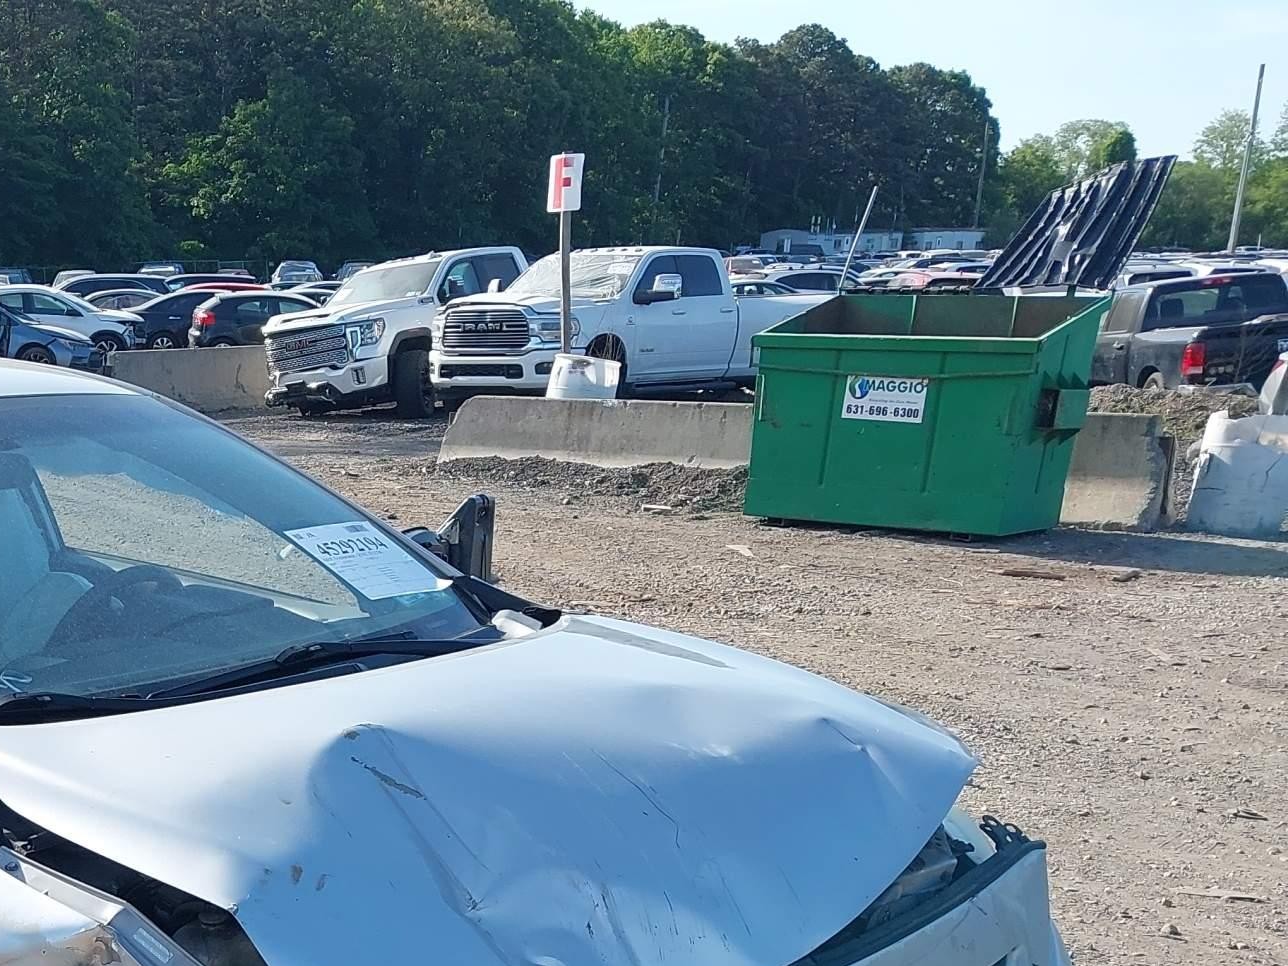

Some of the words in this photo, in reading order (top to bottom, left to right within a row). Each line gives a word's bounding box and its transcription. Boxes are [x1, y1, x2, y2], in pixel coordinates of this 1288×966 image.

[552, 156, 575, 210] F
[867, 379, 926, 394] MAGGIO
[845, 403, 920, 418] 631-696-6300
[315, 536, 390, 558] 45292194
